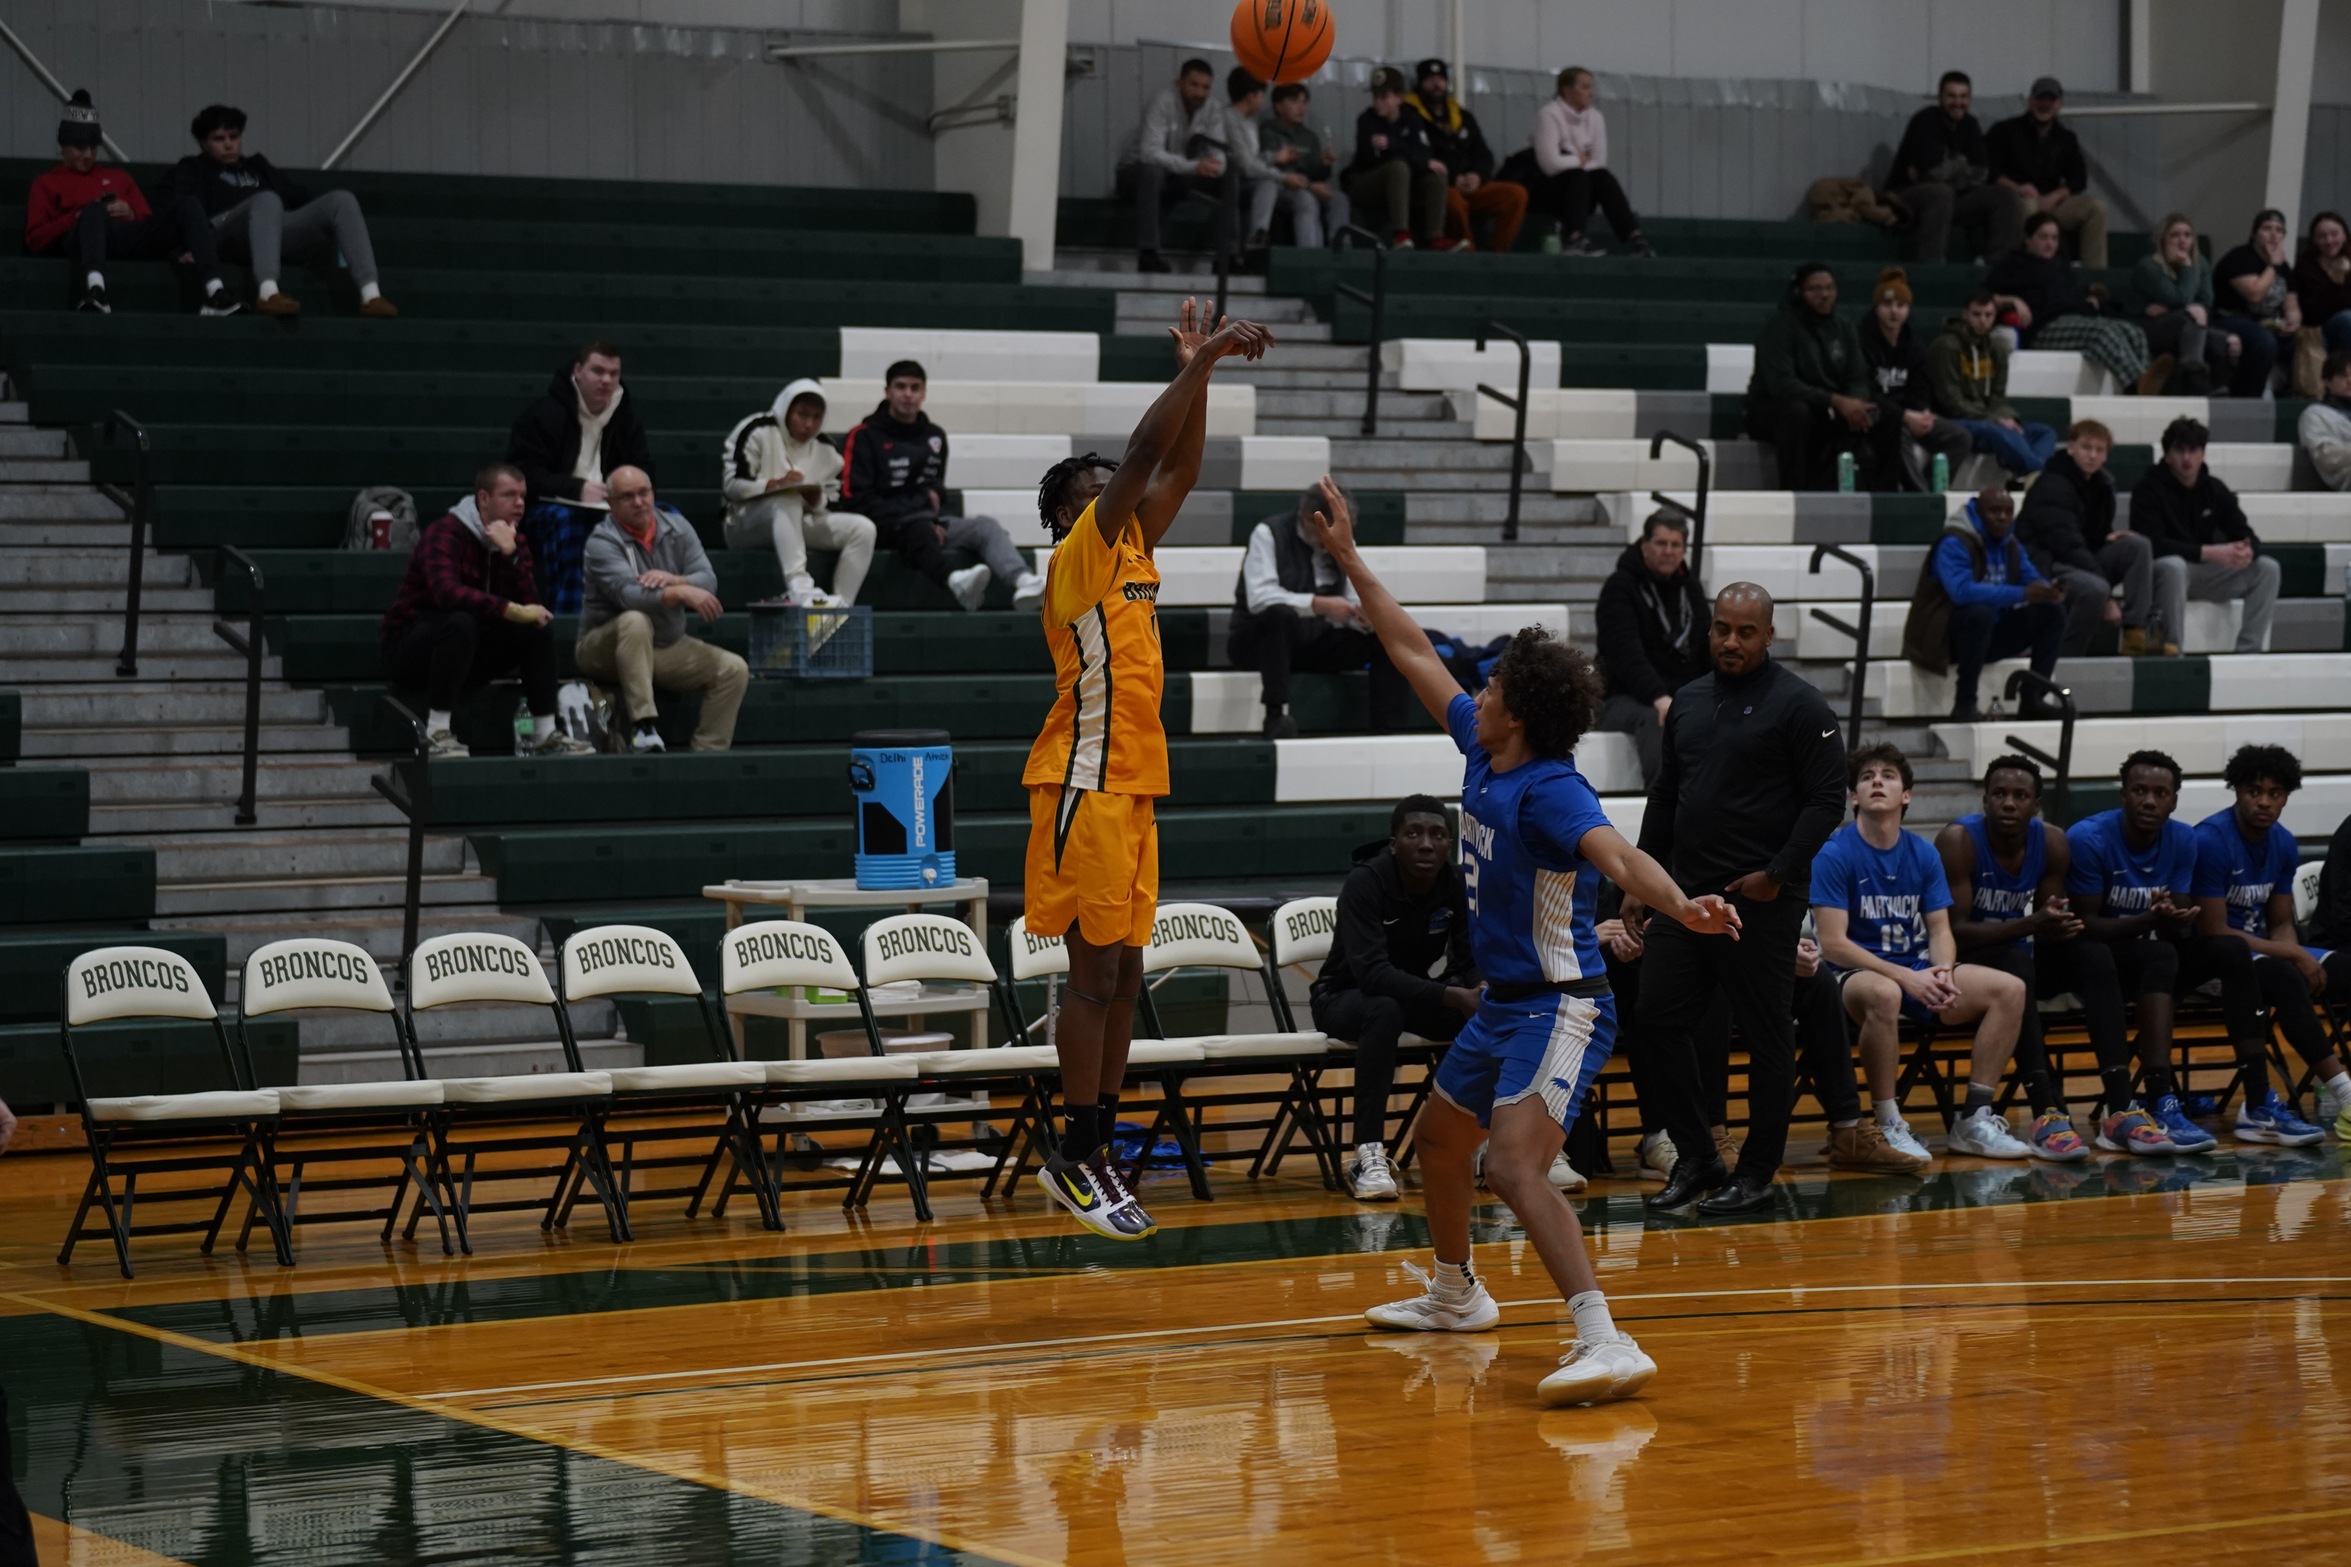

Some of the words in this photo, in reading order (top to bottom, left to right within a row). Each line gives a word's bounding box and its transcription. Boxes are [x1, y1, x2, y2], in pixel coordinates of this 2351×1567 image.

[880, 753, 906, 763] Delhi
[912, 756, 927, 848] POWERADE
[576, 938, 676, 975] BRONCOS
[735, 932, 834, 969] BRONCOS
[877, 925, 973, 962] BRONCOS
[81, 959, 190, 999] BRONCOS
[259, 951, 369, 989] BRONCOS
[425, 944, 531, 982] BRONCOS
